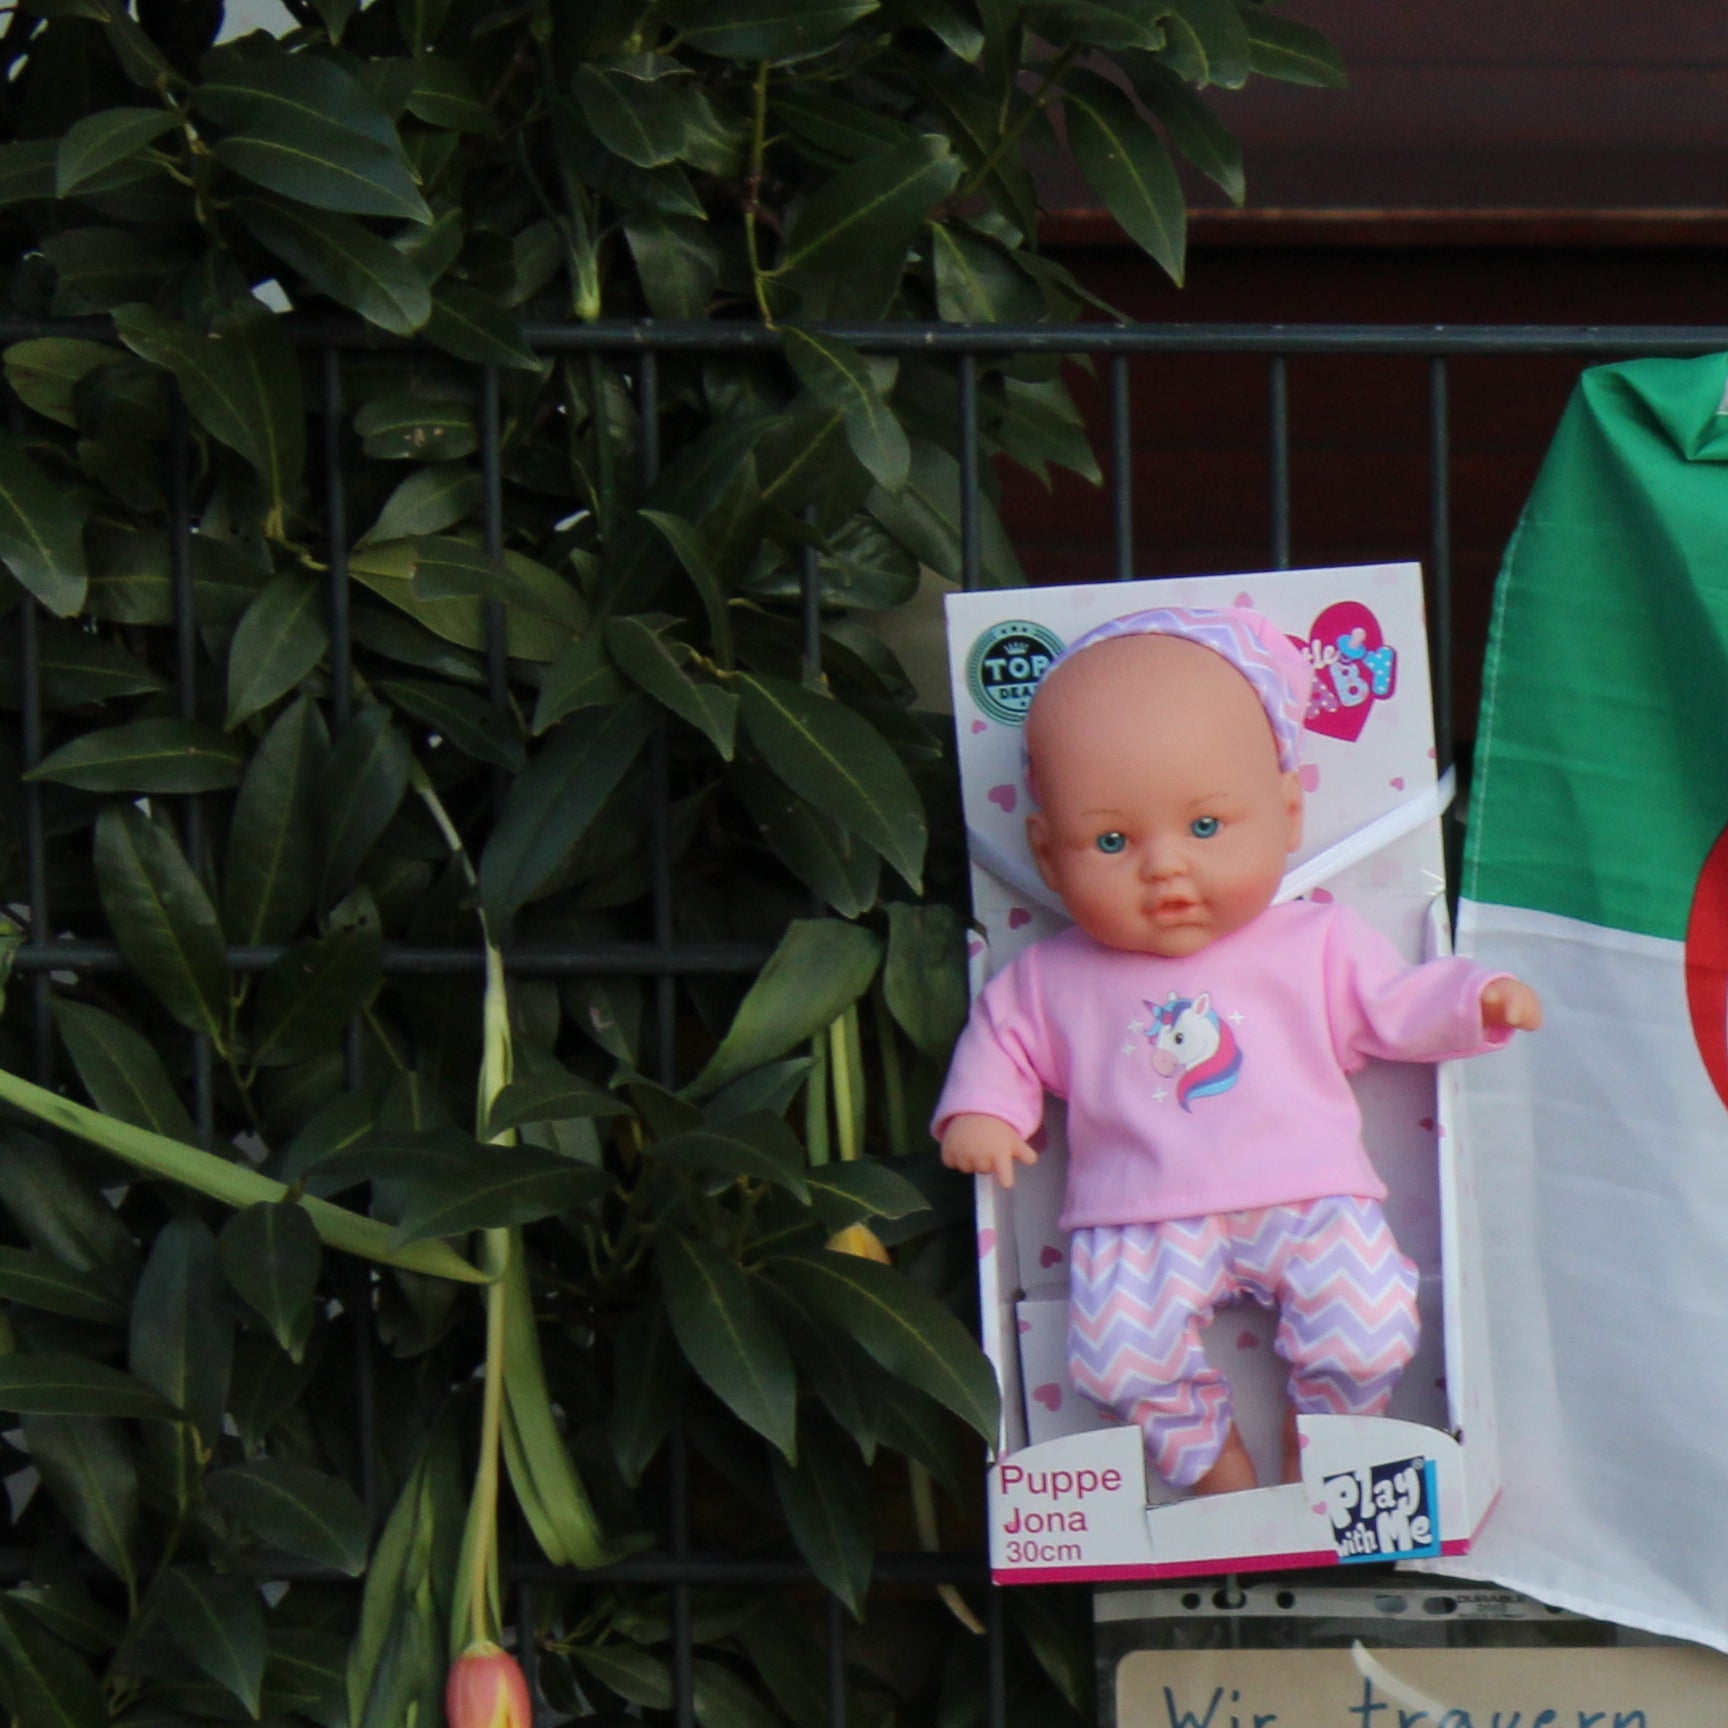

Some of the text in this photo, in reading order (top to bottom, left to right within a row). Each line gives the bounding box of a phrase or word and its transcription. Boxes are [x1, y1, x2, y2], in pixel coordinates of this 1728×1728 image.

[984, 655, 1050, 681] TOP
[1001, 687, 1034, 699] DEA
[1000, 1464, 1122, 1501] Puppe
[1322, 1464, 1421, 1529] Play
[1004, 1507, 1088, 1535] Jona
[1339, 1511, 1434, 1558] with Me
[1006, 1539, 1083, 1564] 30cm
